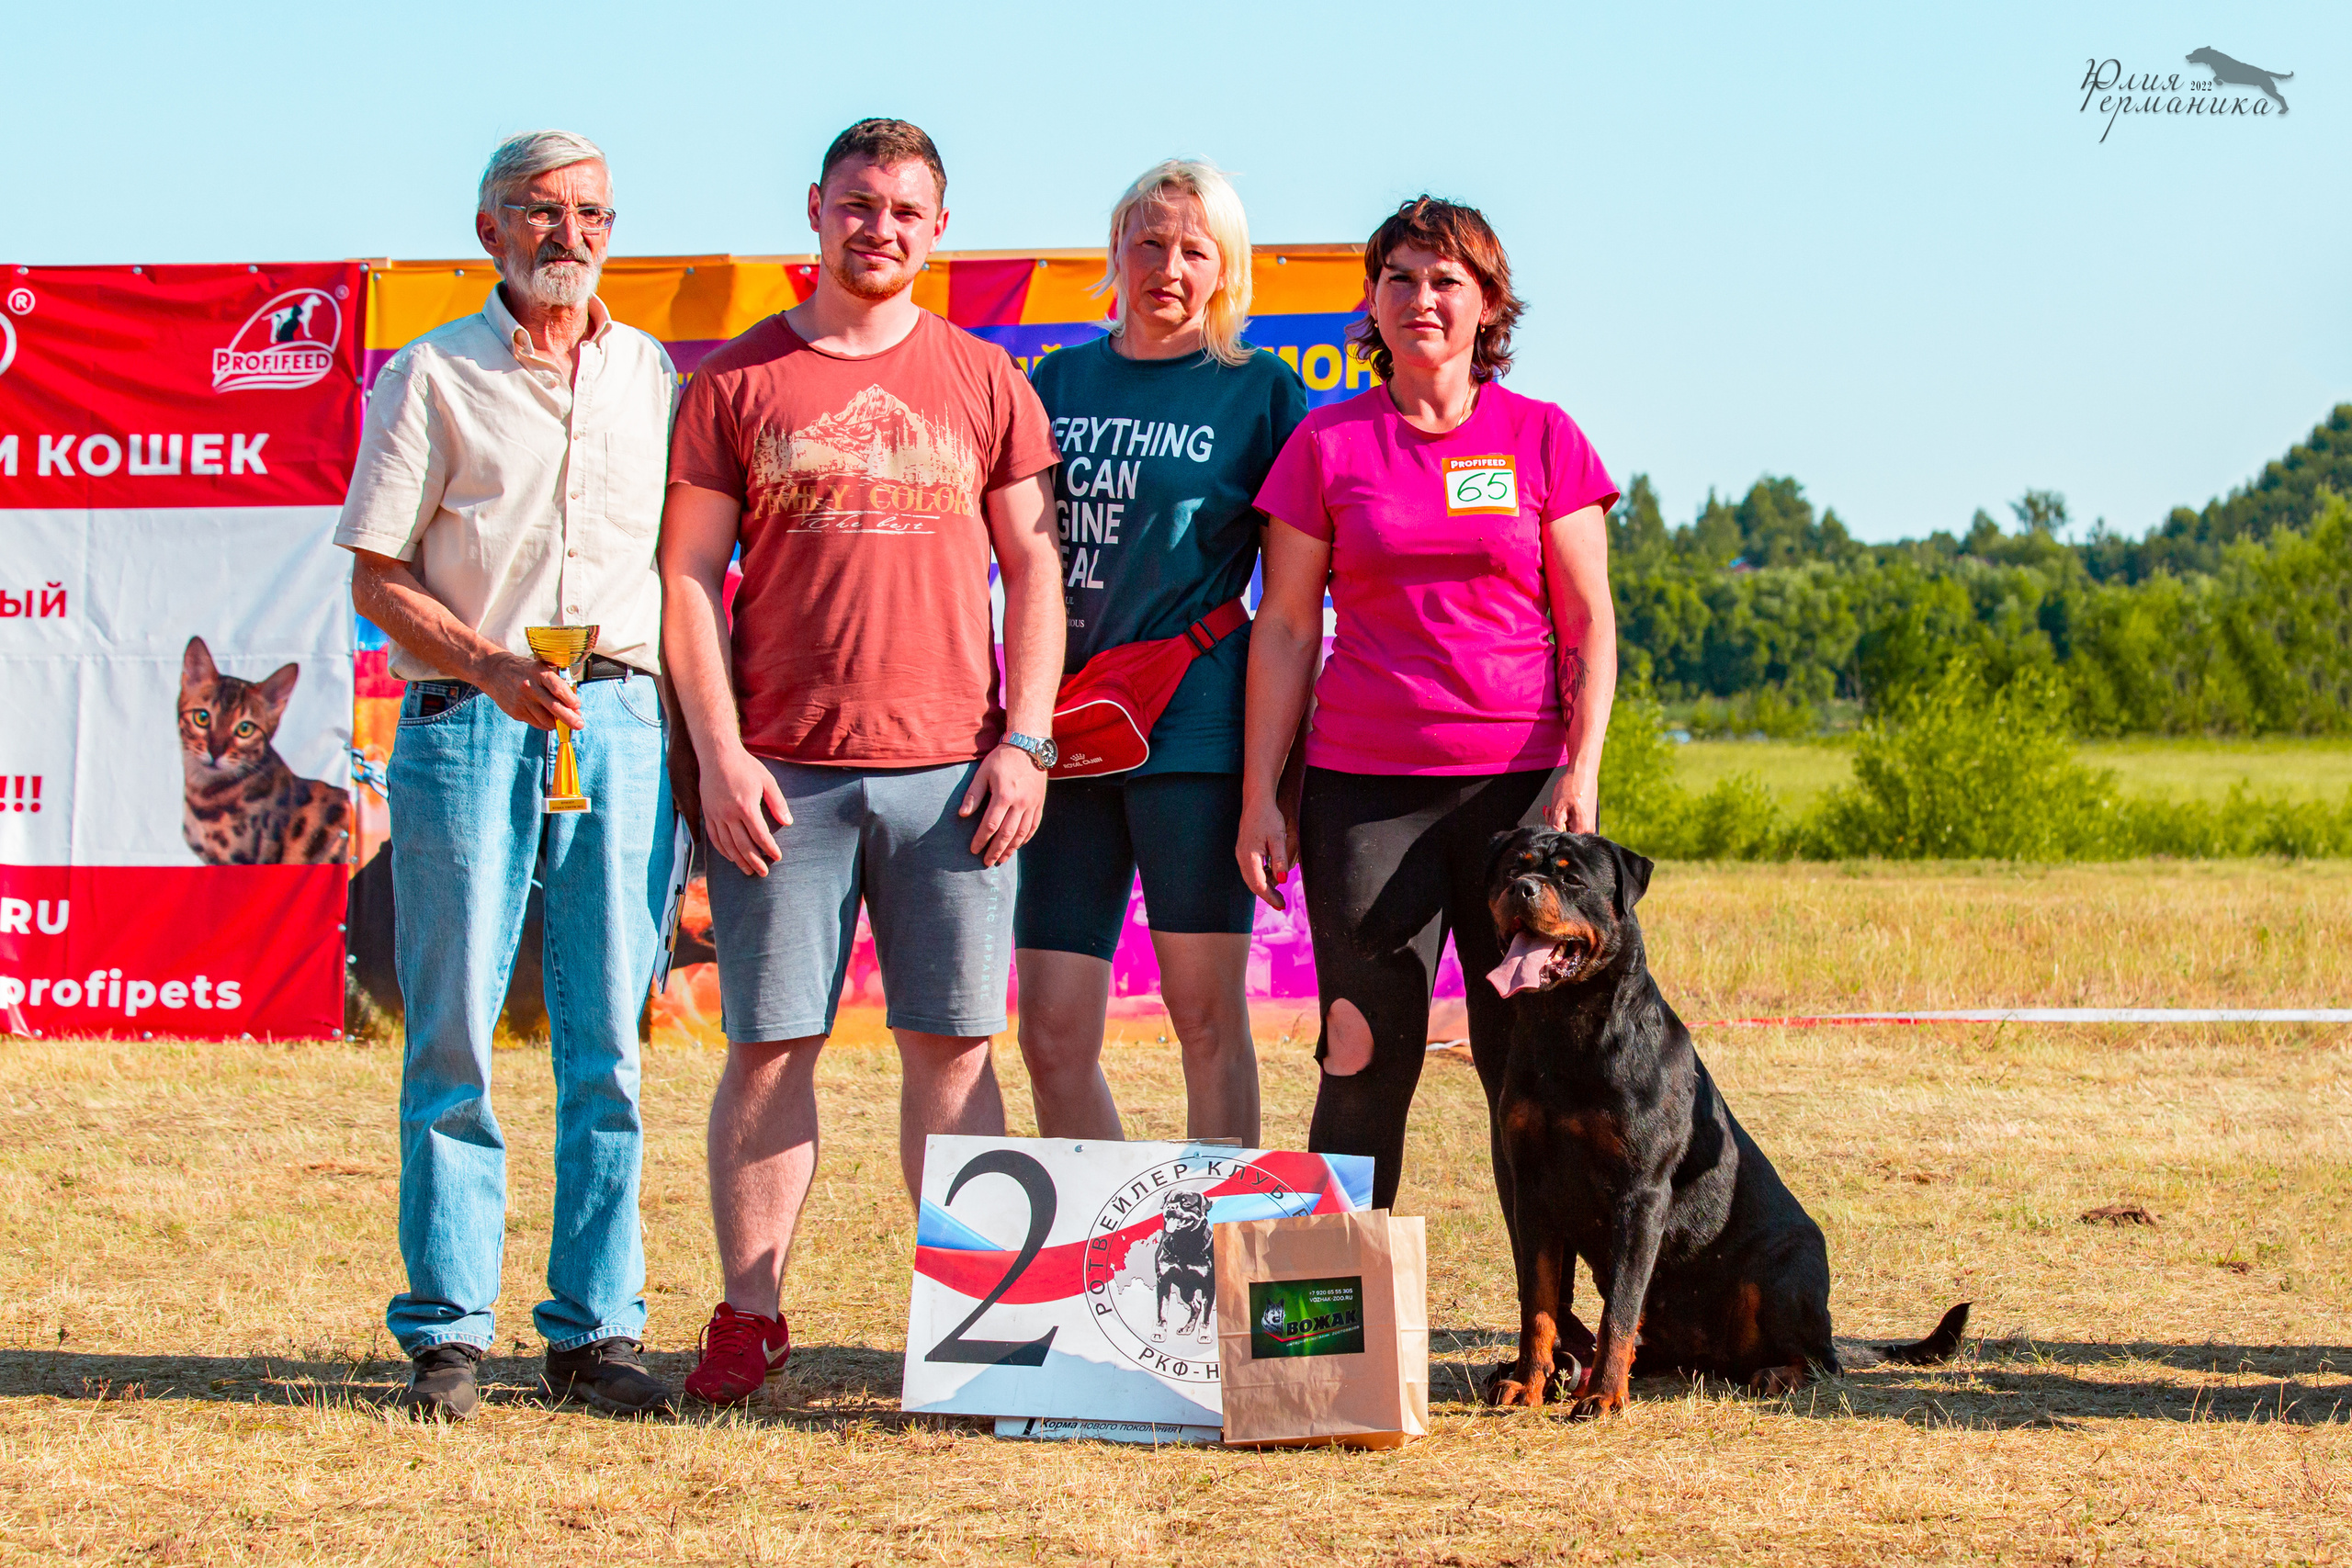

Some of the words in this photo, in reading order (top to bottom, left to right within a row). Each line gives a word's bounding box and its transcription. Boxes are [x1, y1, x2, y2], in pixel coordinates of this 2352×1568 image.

[214, 349, 332, 373] PROFIFEED
[38, 434, 269, 477] КОШЕК
[1051, 416, 1215, 462] ERYTHING
[1067, 457, 1141, 500] CAN
[1450, 458, 1507, 469] PROFIFEED
[868, 485, 975, 517] COLORS
[1456, 471, 1512, 502] 65
[800, 514, 862, 529] The
[876, 516, 924, 531] best
[1056, 500, 1125, 544] GINE
[1060, 546, 1104, 590] EAL
[987, 866, 1000, 923] HLETIC
[979, 933, 993, 1000] APPAREL
[924, 1149, 1059, 1367] 2
[1089, 1164, 1188, 1316] РОТВЕЙЛЕР
[1207, 1160, 1287, 1201] КЛУБ
[1286, 1309, 1358, 1337] ВОЖАК
[1040, 1419, 1079, 1430] Корма
[1080, 1422, 1117, 1431] нового
